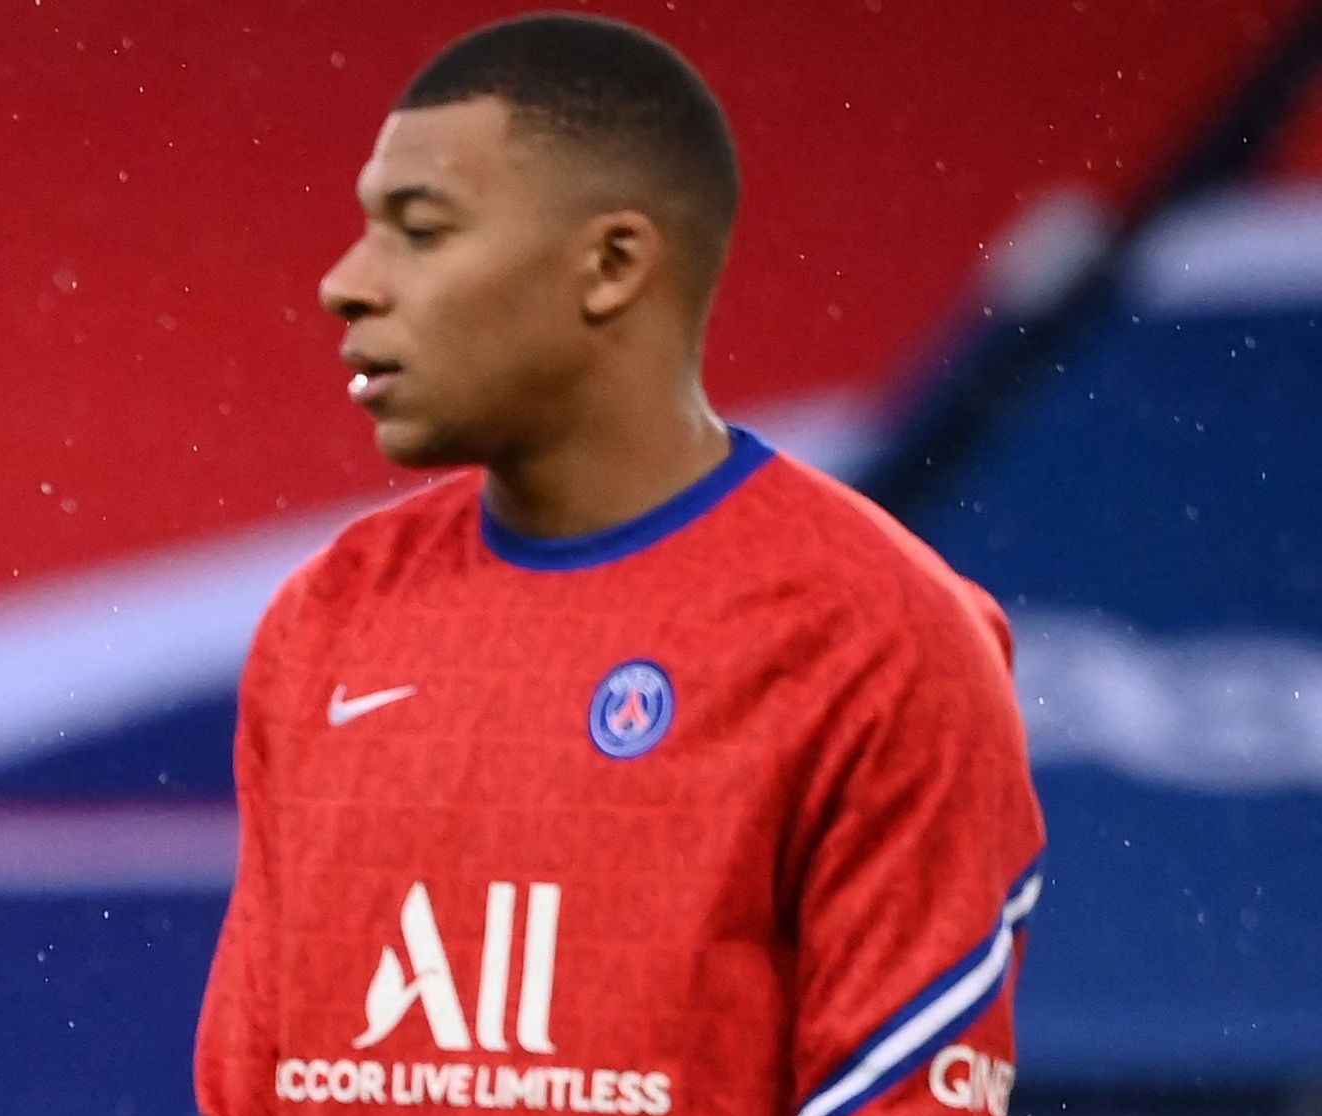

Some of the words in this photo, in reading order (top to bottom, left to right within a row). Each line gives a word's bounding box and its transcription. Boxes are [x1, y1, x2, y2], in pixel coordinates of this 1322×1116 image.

[276, 1058, 386, 1103] CCOR
[392, 1061, 473, 1106] LIVE
[475, 1064, 672, 1116] LIMITLESS
